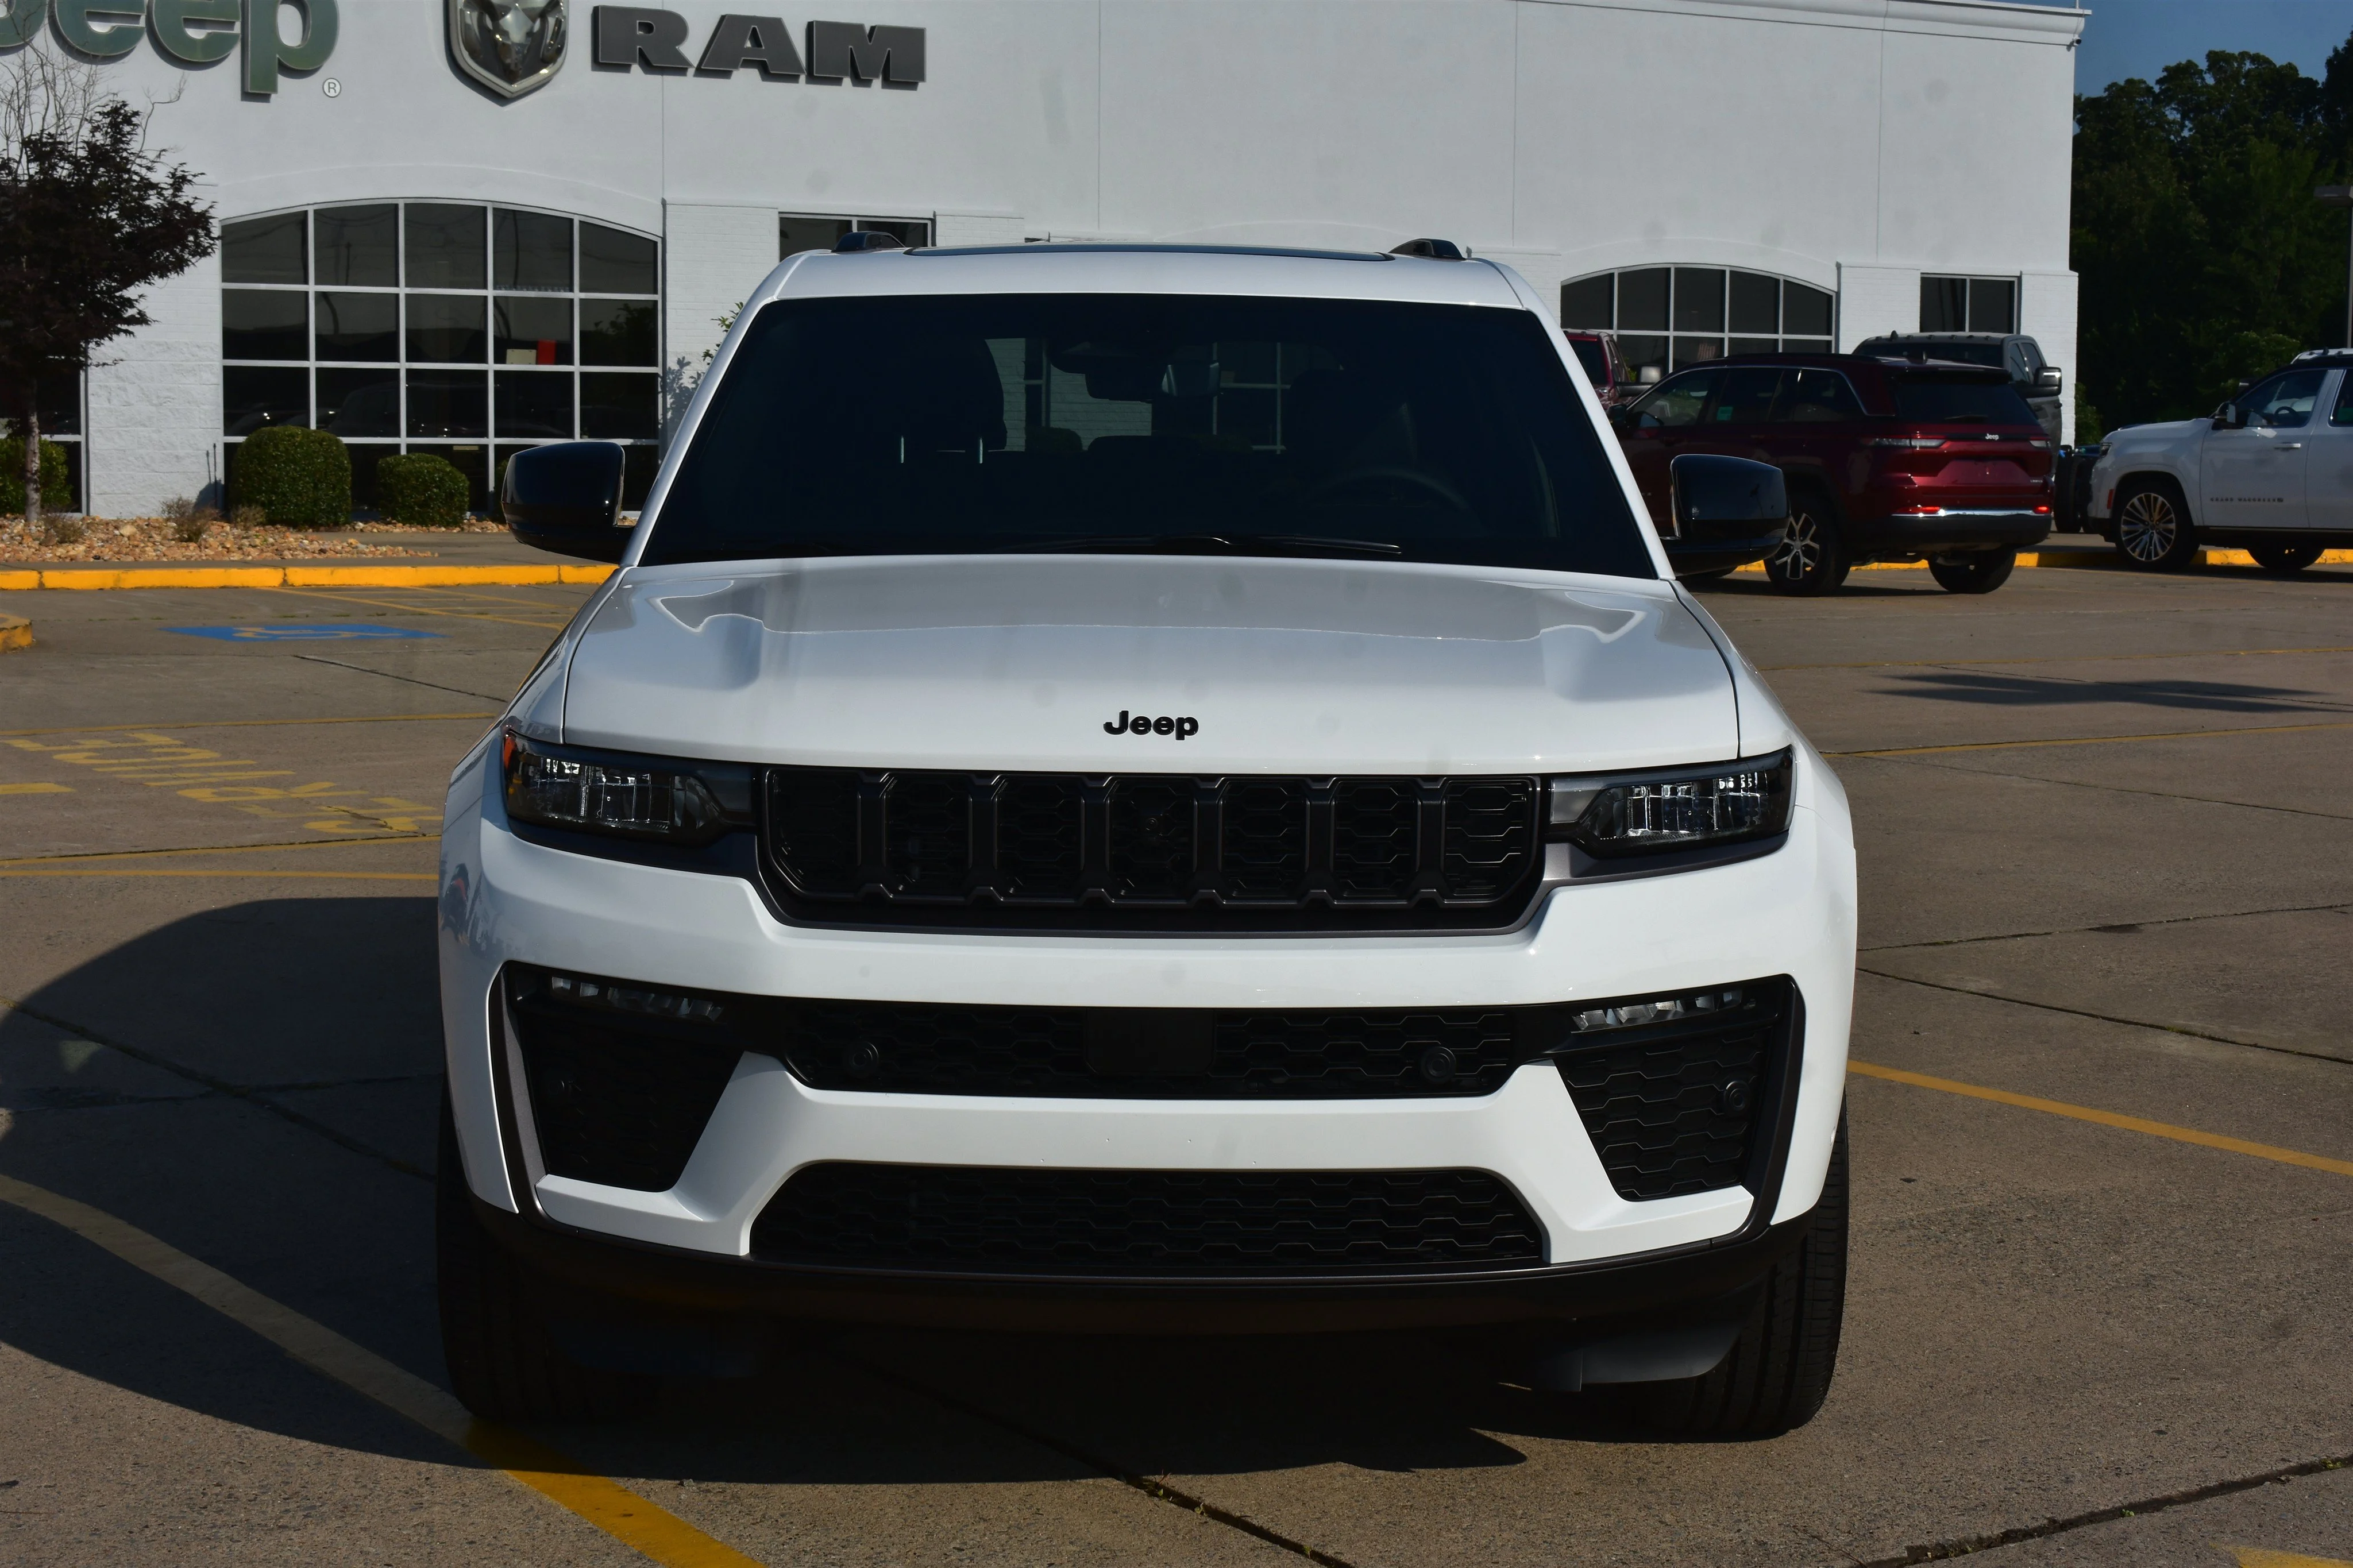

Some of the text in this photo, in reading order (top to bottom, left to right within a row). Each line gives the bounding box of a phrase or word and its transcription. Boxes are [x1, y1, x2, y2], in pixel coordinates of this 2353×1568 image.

[0, 0, 338, 94] eep
[596, 5, 927, 83] RAM
[1103, 710, 1199, 740] Jeep
